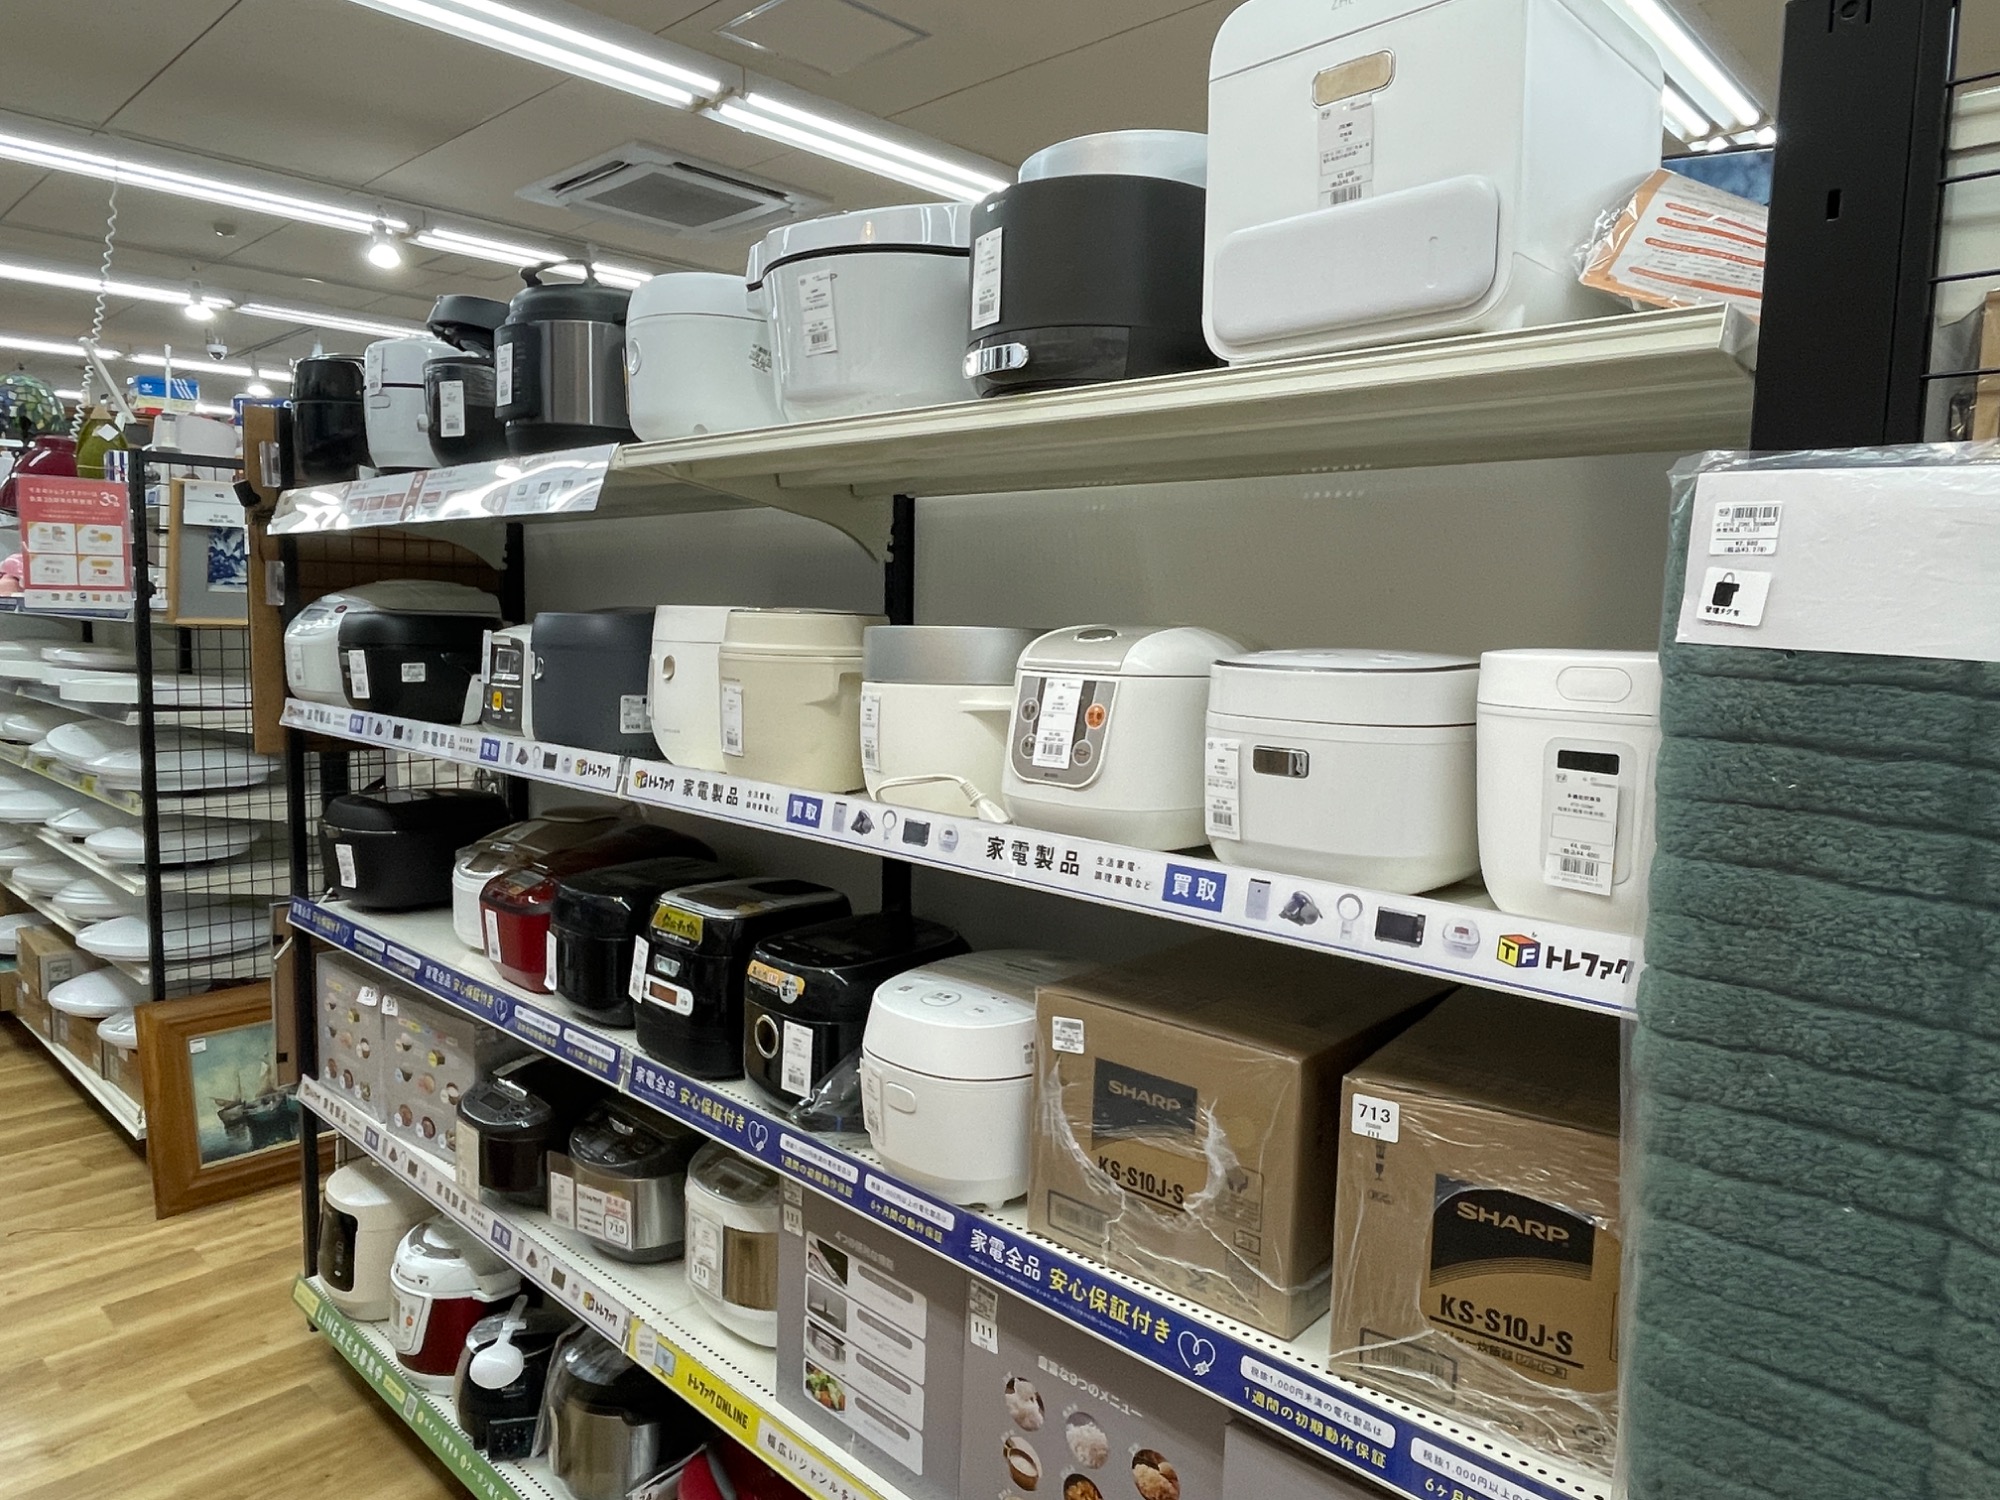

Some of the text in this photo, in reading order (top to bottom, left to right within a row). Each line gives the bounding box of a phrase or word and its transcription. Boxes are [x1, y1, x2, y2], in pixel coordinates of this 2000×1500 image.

[683, 778, 739, 807] 家電製品
[790, 799, 817, 822] 買取
[985, 836, 1081, 877] 家電製品
[1094, 871, 1153, 892] 調理家電など
[1171, 872, 1217, 904] 買取
[1546, 945, 1634, 985] トレファク
[635, 1065, 676, 1099] 家電全品
[680, 1086, 745, 1133] 安心保証付き
[1107, 1079, 1182, 1112] SHARP
[1358, 1102, 1391, 1124] 713
[1098, 1155, 1185, 1205] KS-S10J-S
[1456, 1201, 1570, 1243] SHARP
[969, 1228, 1042, 1282] 家電全品
[1048, 1267, 1171, 1345] 安心保証付き
[975, 1321, 992, 1339] 111
[1439, 1293, 1574, 1357] KS-S10J-S
[687, 1372, 749, 1430] トレファク ONLINE
[1243, 1386, 1387, 1470] 1週間の初期動作保証
[767, 1432, 858, 1500] 幅広いジャンルを
